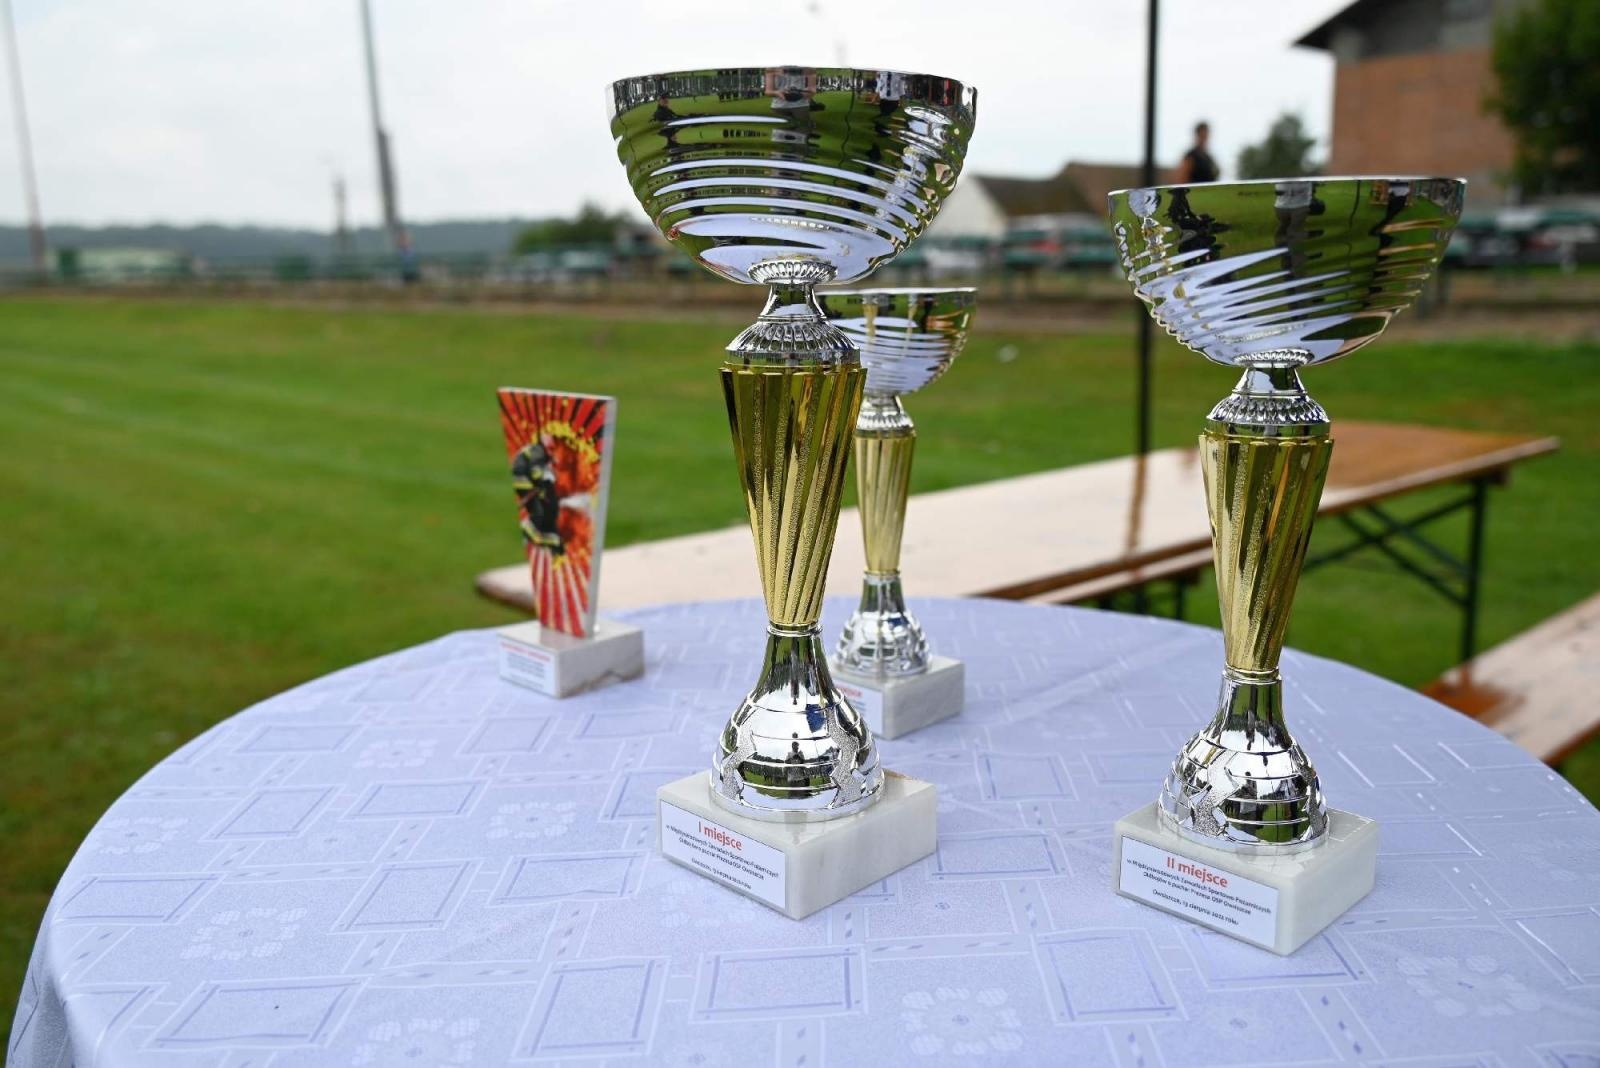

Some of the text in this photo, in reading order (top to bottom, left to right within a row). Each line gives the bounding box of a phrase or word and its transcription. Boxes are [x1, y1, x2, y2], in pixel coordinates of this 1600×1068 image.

[703, 826, 743, 851] miejsce
[1166, 856, 1228, 888] II miejsce
